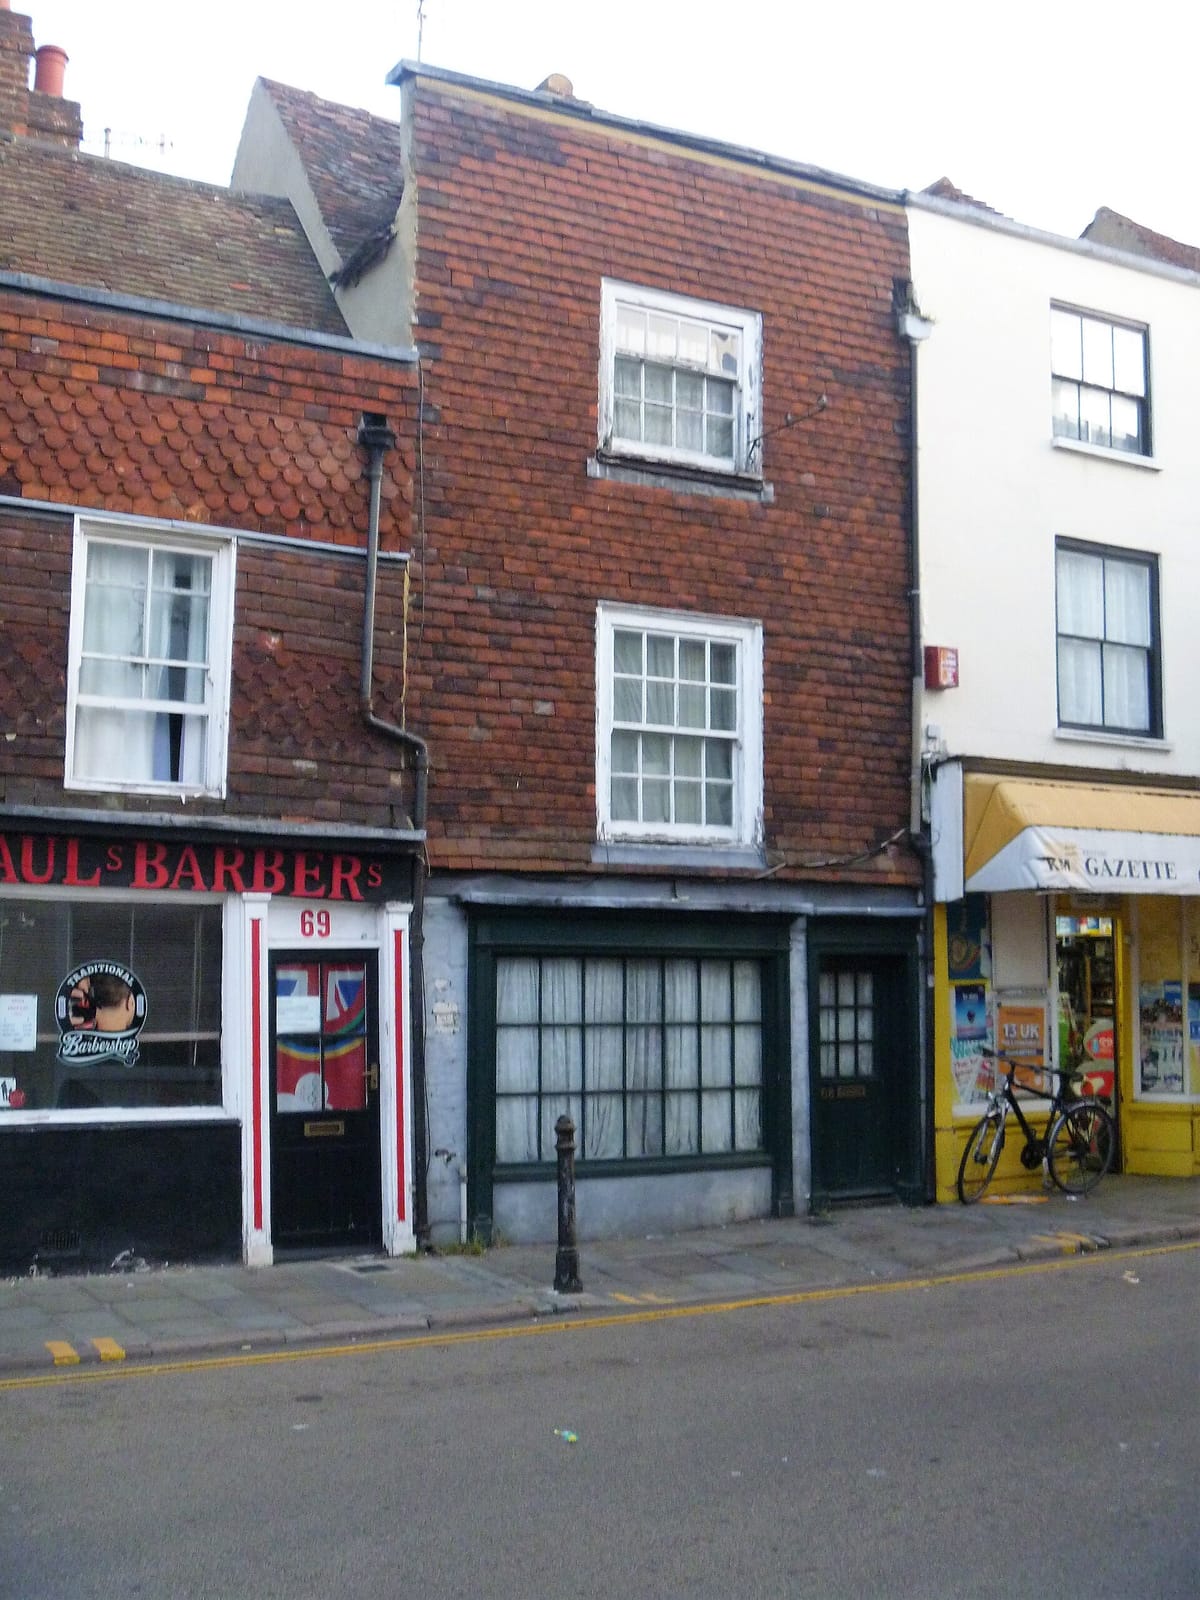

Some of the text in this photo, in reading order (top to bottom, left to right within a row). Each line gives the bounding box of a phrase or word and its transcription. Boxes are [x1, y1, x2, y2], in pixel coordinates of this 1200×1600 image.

[1085, 857, 1177, 880] GAZETTE
[300, 909, 331, 937] 69
[67, 964, 135, 987] TRADITIONAL
[62, 1031, 137, 1056] Barbershop
